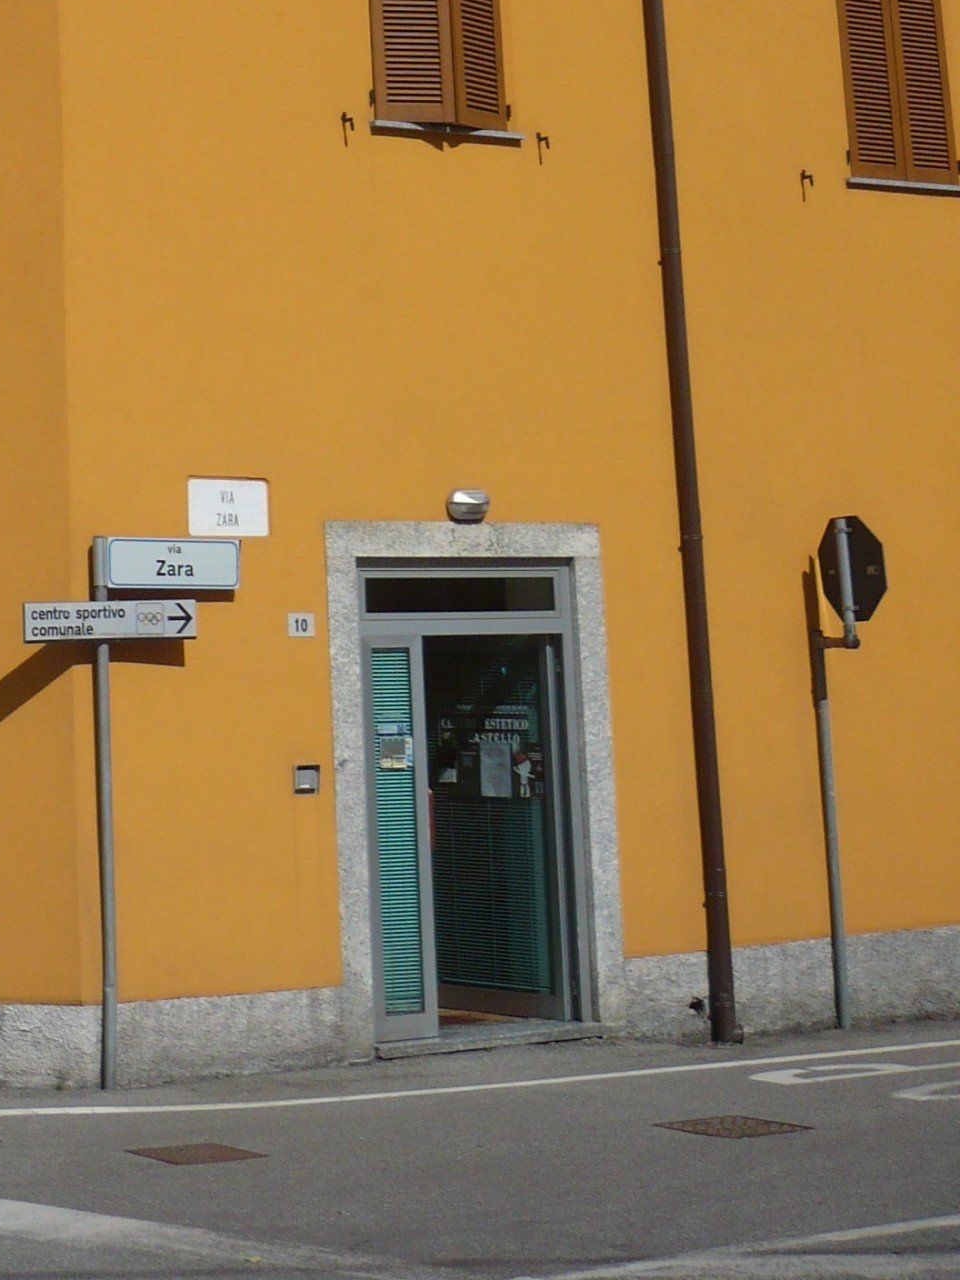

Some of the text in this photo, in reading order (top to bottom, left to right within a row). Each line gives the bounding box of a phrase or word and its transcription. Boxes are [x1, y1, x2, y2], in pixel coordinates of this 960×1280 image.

[219, 490, 235, 504] VIA
[216, 513, 239, 527] ZARA
[167, 544, 182, 554] via
[156, 560, 194, 577] Zara
[30, 604, 126, 623] centro sportivo
[31, 623, 94, 637] comunale
[294, 618, 308, 632] 10
